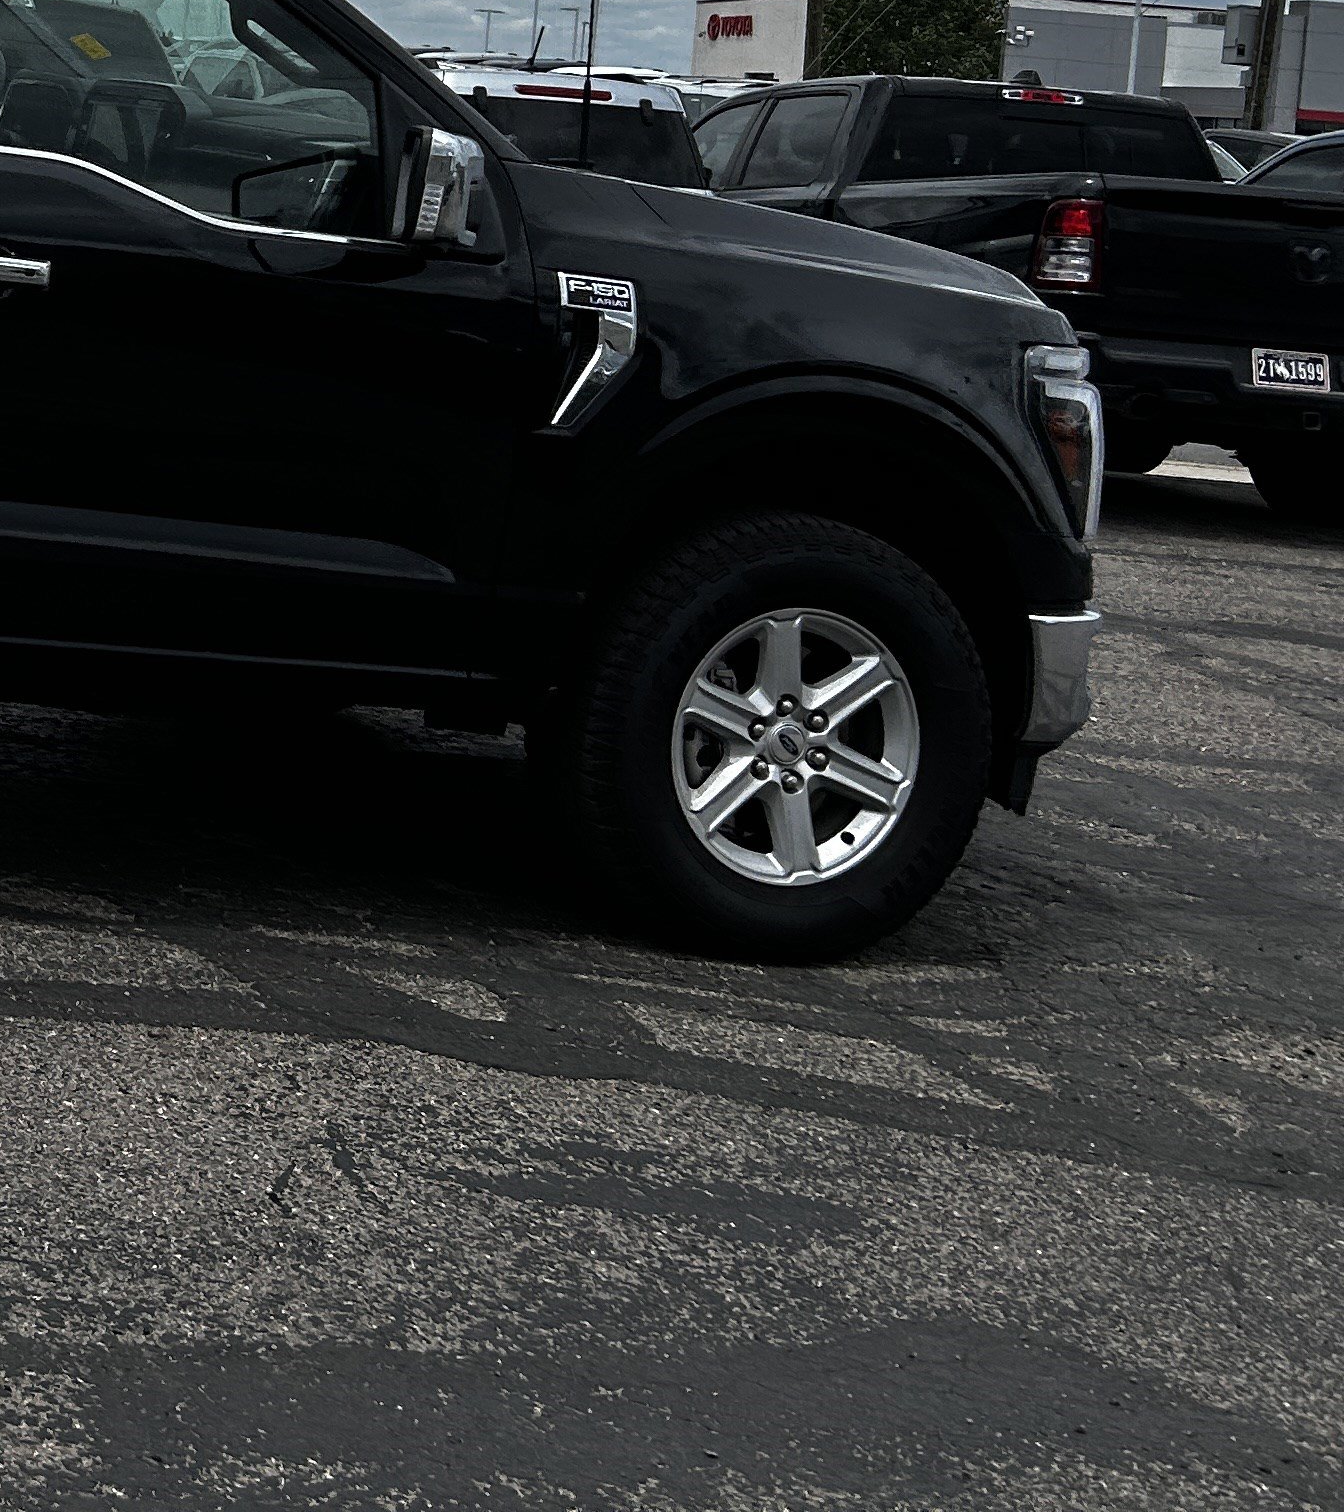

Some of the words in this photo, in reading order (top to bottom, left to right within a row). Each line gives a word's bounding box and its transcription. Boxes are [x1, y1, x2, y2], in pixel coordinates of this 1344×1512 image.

[720, 15, 753, 37] TOYOTA
[568, 279, 630, 299] F-150
[589, 295, 629, 308] LARIAT
[1289, 361, 1324, 381] 1599
